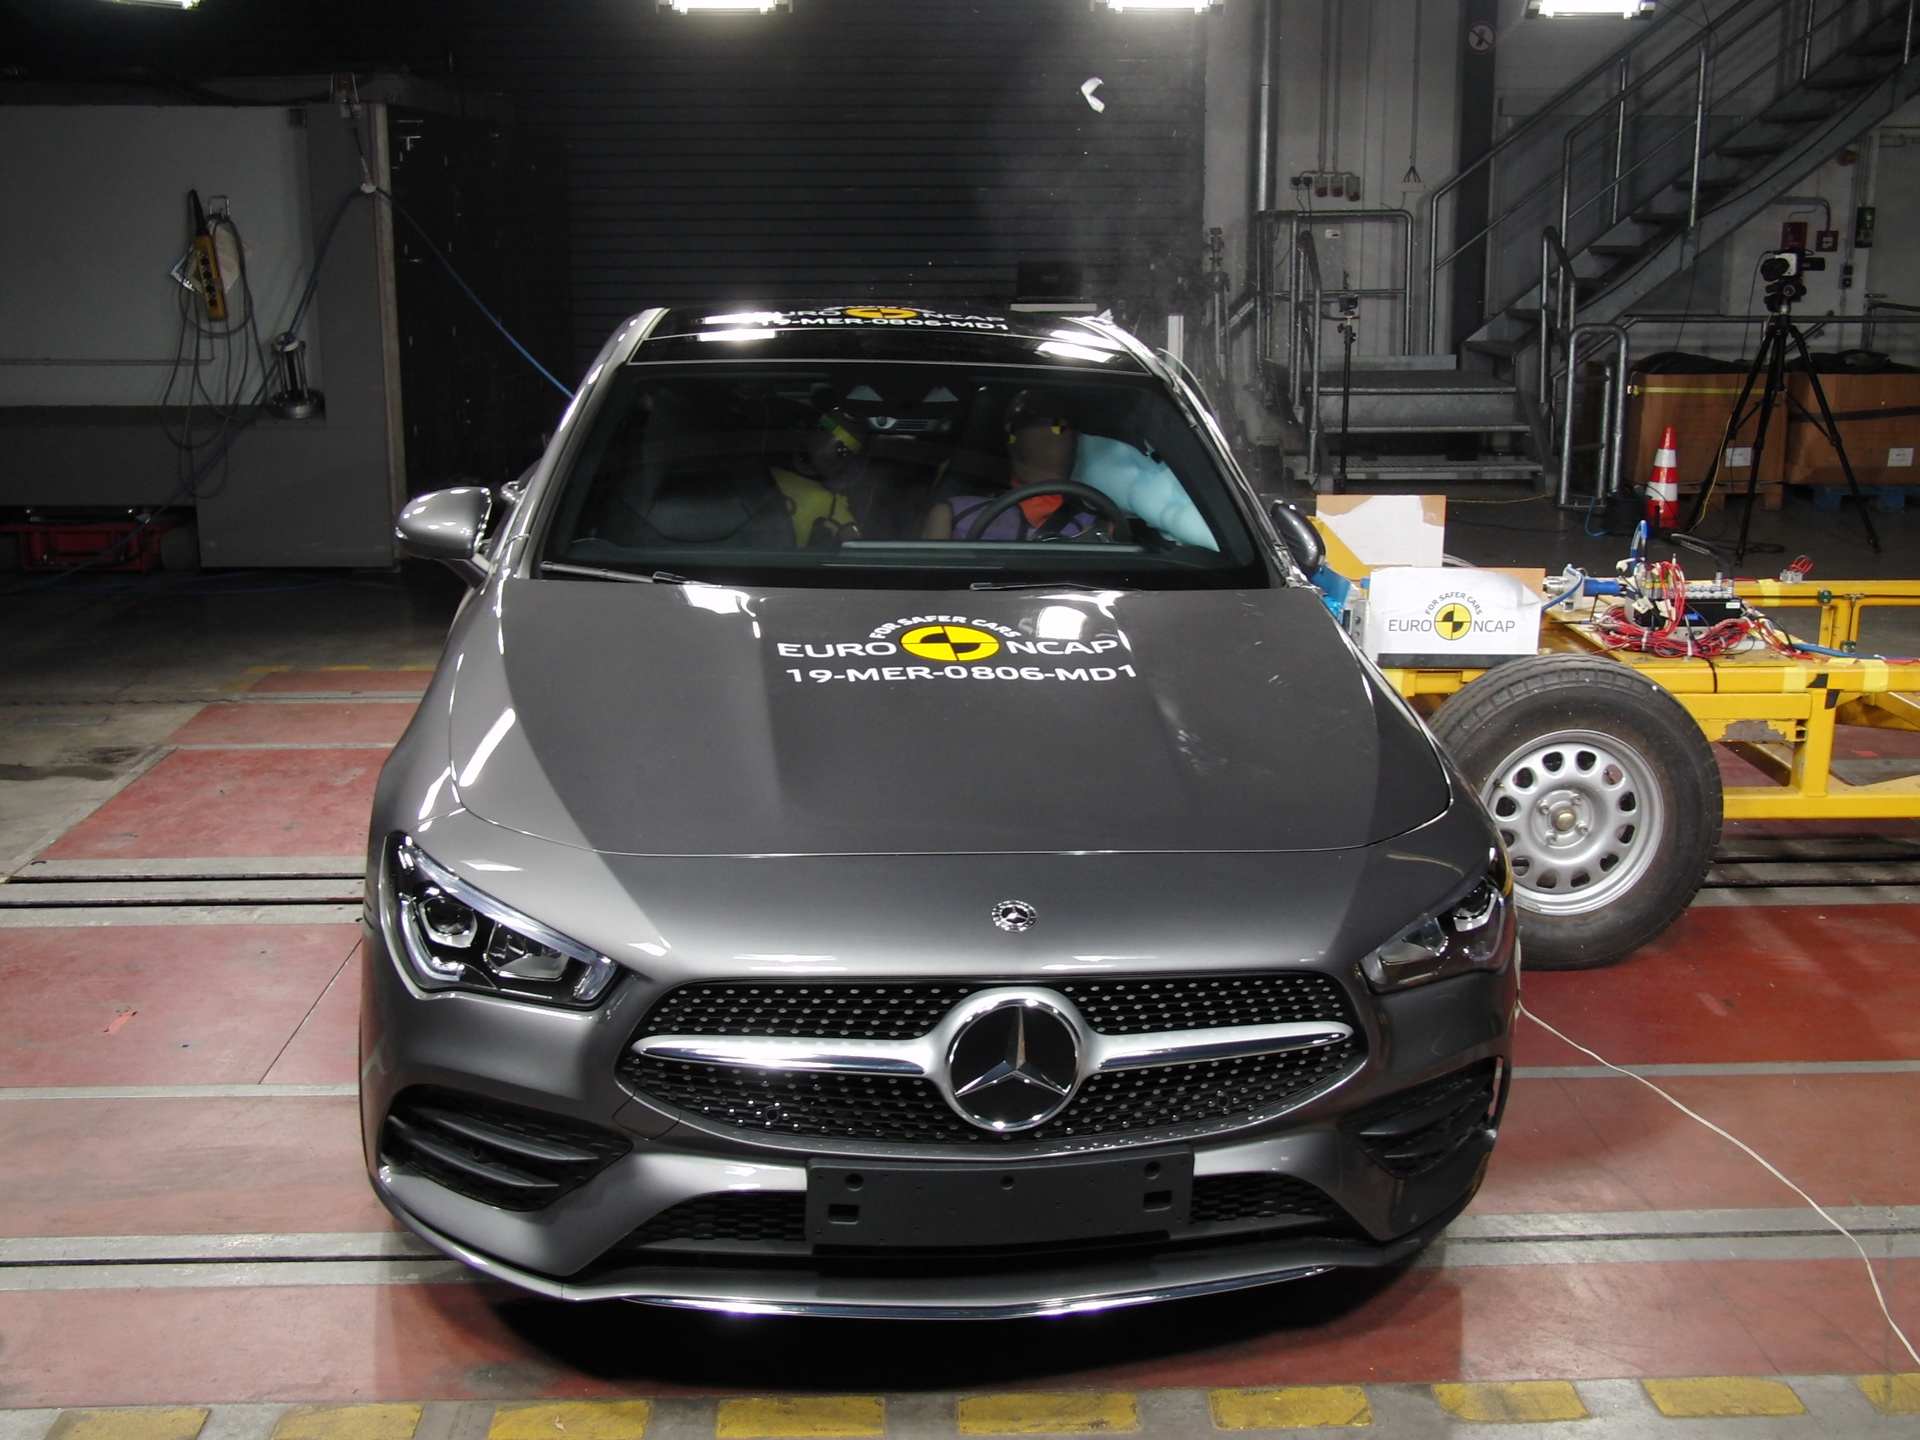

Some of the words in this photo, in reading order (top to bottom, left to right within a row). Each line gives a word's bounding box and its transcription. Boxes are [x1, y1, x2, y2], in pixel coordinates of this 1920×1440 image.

[922, 313, 1005, 322] NCAP
[1424, 599, 1440, 616] FOR
[1438, 591, 1467, 602] SAFER
[1466, 596, 1483, 616] CARS
[868, 622, 902, 639] FOR
[897, 615, 967, 626] SAFER
[971, 619, 1022, 638] CARS
[1388, 619, 1432, 632] EURO
[1472, 620, 1516, 633] NCAP
[777, 642, 897, 658] EURO
[1005, 640, 1118, 655] NCAP
[785, 664, 1137, 683] 19-MER-0806-MD1
